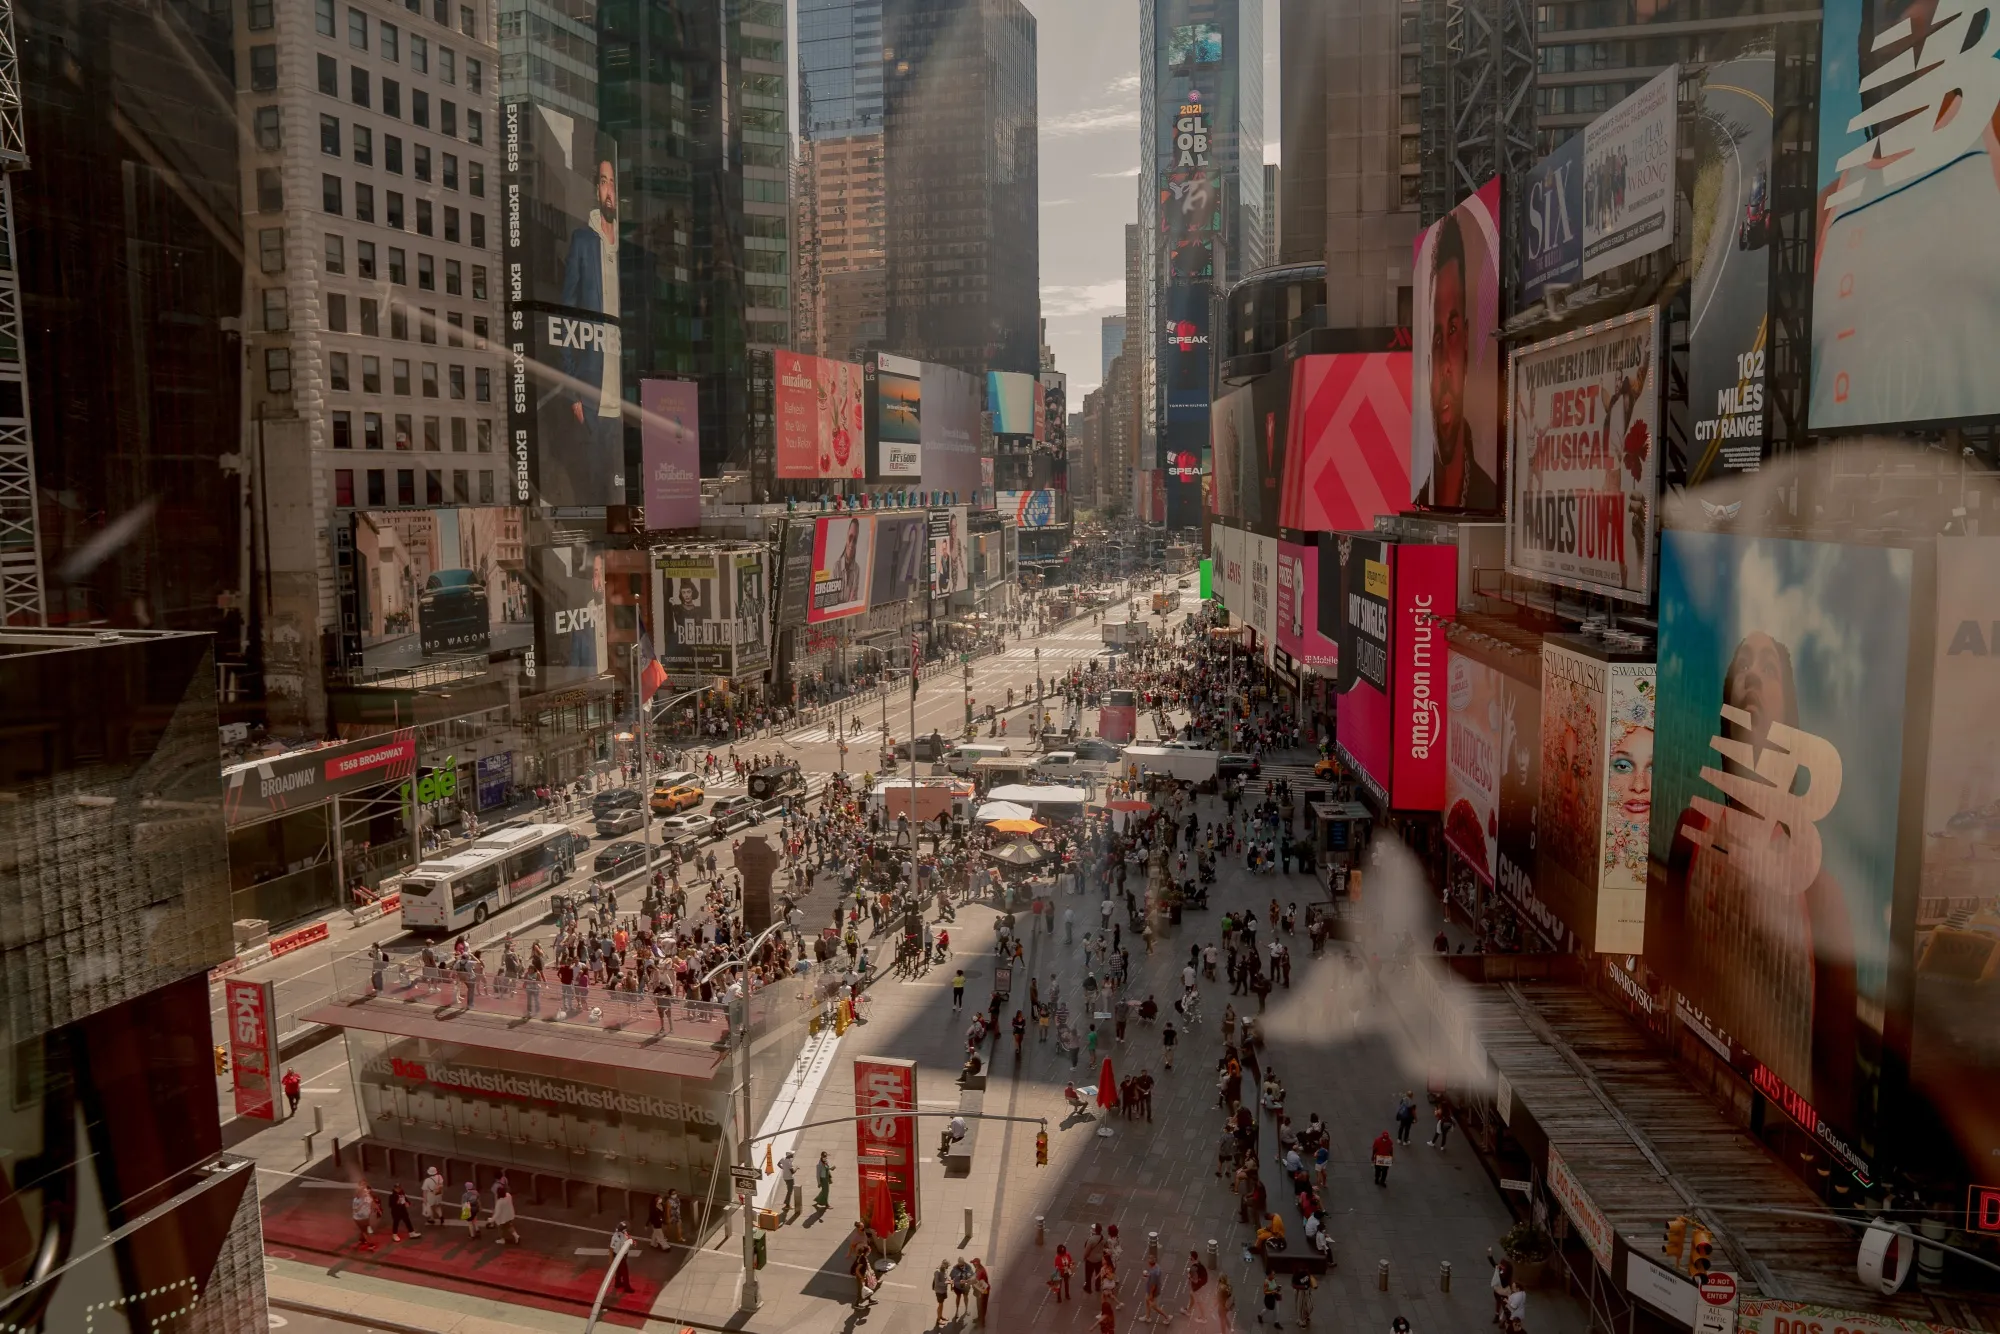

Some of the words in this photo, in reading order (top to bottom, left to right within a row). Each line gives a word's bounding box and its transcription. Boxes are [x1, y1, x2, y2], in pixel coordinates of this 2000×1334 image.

[1180, 104, 1202, 114] 2021
[1637, 91, 1656, 112] SMASH
[1656, 82, 1666, 99] HIT
[506, 103, 518, 173] EXPRESS
[1631, 135, 1644, 149] THE
[1644, 117, 1664, 142] PLAY
[1644, 138, 1668, 164] GOES
[1627, 163, 1668, 193] WRONG
[508, 184, 521, 248] EXPRESS
[1528, 160, 1574, 260] SIX
[1168, 335, 1208, 345] SPEAK
[512, 342, 526, 414] EXPRESS
[782, 373, 812, 390] miraflora
[1526, 354, 1578, 391] WINNER!
[1585, 347, 1606, 378] TONY
[1607, 335, 1642, 373] AWARDS
[1737, 349, 1765, 380] 102
[1551, 385, 1599, 429] BEST
[1717, 383, 1763, 416] MILES
[1536, 428, 1615, 471] MUSICAL
[1695, 420, 1720, 441] CITY
[1721, 415, 1763, 439] RANGE
[515, 429, 529, 501] EXPRESS
[655, 469, 694, 481] Doubtfire
[1522, 489, 1626, 563] HADESTOWN
[826, 579, 842, 593] CRESPO
[1349, 592, 1361, 629] HOT
[1361, 597, 1387, 642] SINGLES
[1409, 594, 1433, 667] music
[399, 639, 440, 654] GRAND
[447, 628, 507, 646] WAGONEER
[1356, 636, 1387, 687] PLAYLIST
[1544, 650, 1605, 693] SWAROVSKI
[555, 689, 588, 705] EXPRESS
[1411, 671, 1432, 760] amazon
[340, 761, 358, 772] 1568
[358, 746, 404, 767] BROADWAY
[1451, 719, 1492, 792] WAITRESS
[260, 767, 316, 798] BROADWAY
[417, 797, 450, 812] OCCER
[1499, 852, 1564, 941] CHICAGO
[1609, 961, 1652, 1014] SWAROVSKI
[235, 986, 260, 1043] tkts
[868, 1071, 904, 1139] tkts
[1556, 1167, 1569, 1198] DOS
[1570, 1187, 1601, 1245] CAMINOS
[1703, 1314, 1727, 1324] TRAFFIC
[1709, 1307, 1722, 1316] ALL
